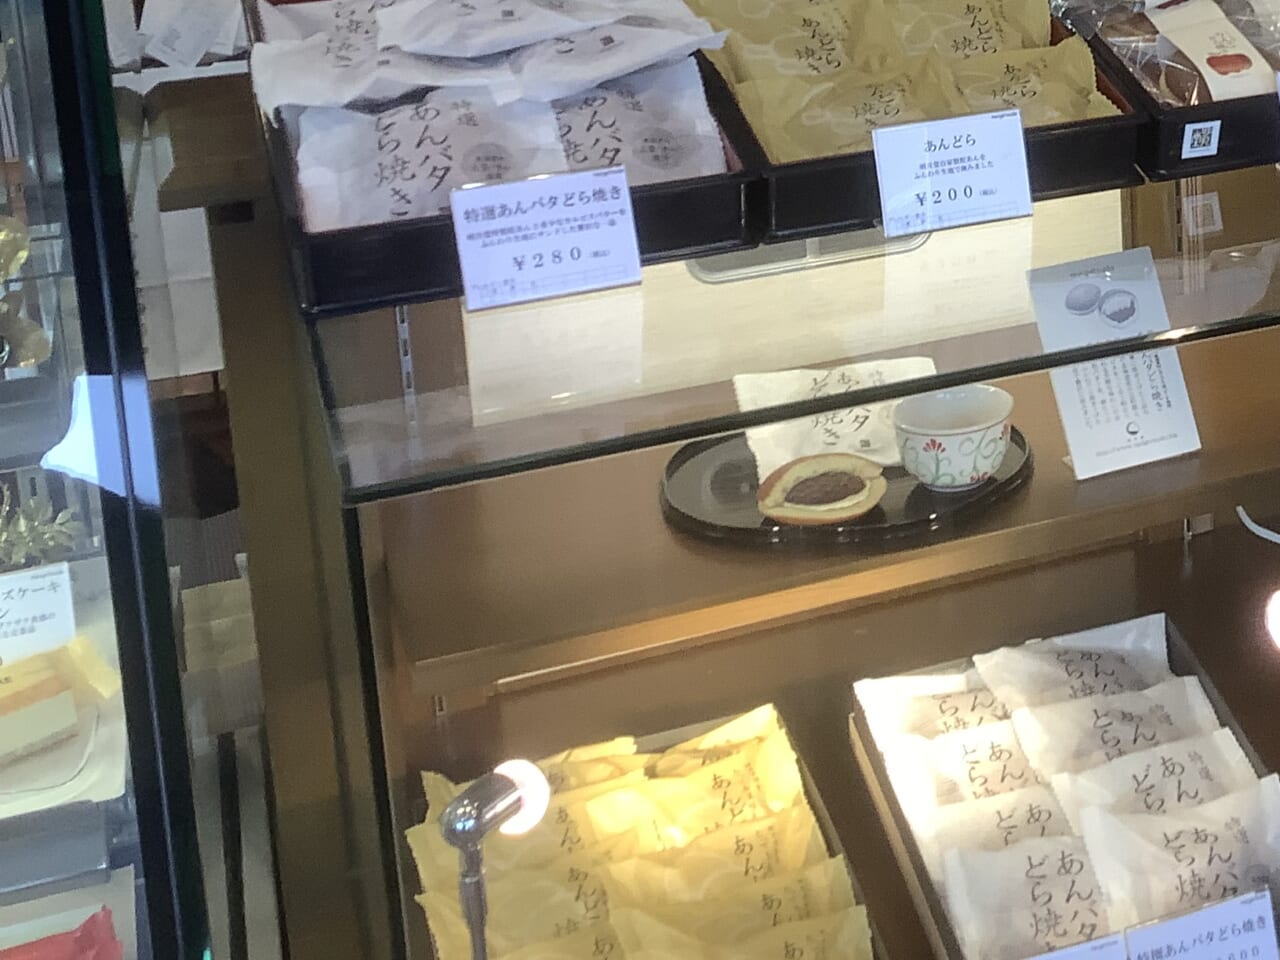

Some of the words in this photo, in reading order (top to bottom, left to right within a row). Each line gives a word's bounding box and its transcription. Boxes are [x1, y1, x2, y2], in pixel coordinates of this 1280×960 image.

[410, 102, 454, 194] あんバタ
[923, 133, 977, 153] あんどら
[463, 185, 622, 223] 特選あんバタどら焼き
[915, 184, 974, 207] ¥200
[512, 245, 582, 272] ¥280
[1056, 851, 1100, 941] あんバタ
